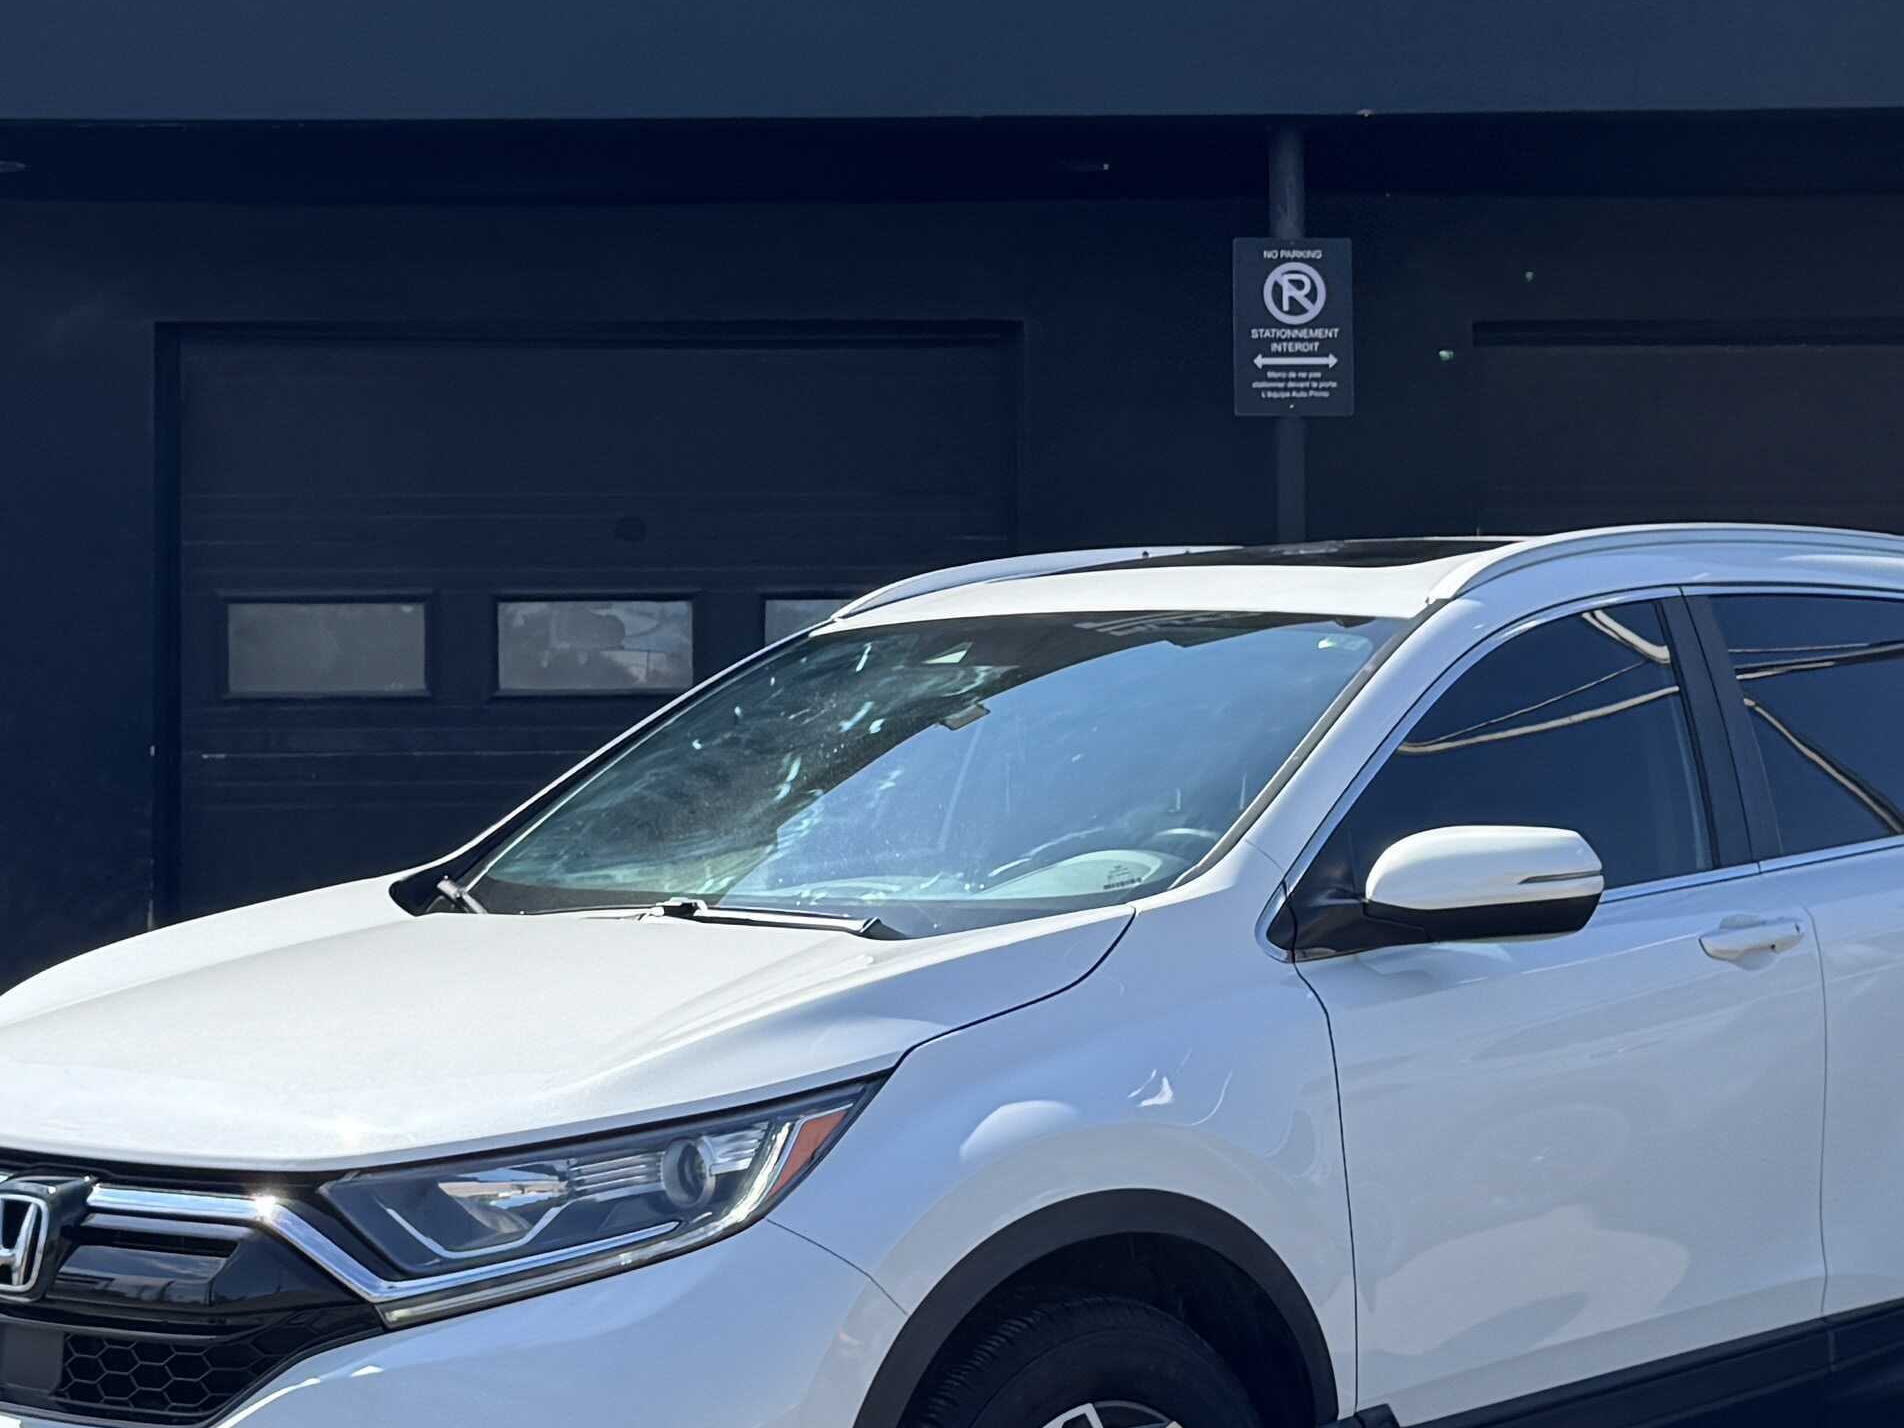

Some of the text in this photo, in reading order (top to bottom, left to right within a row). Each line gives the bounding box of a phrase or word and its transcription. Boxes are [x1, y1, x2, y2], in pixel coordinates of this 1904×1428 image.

[1263, 249, 1322, 259] NO PARKING
[1250, 327, 1339, 340] STATIONNEMENT
[1270, 341, 1320, 353] INTERDIT
